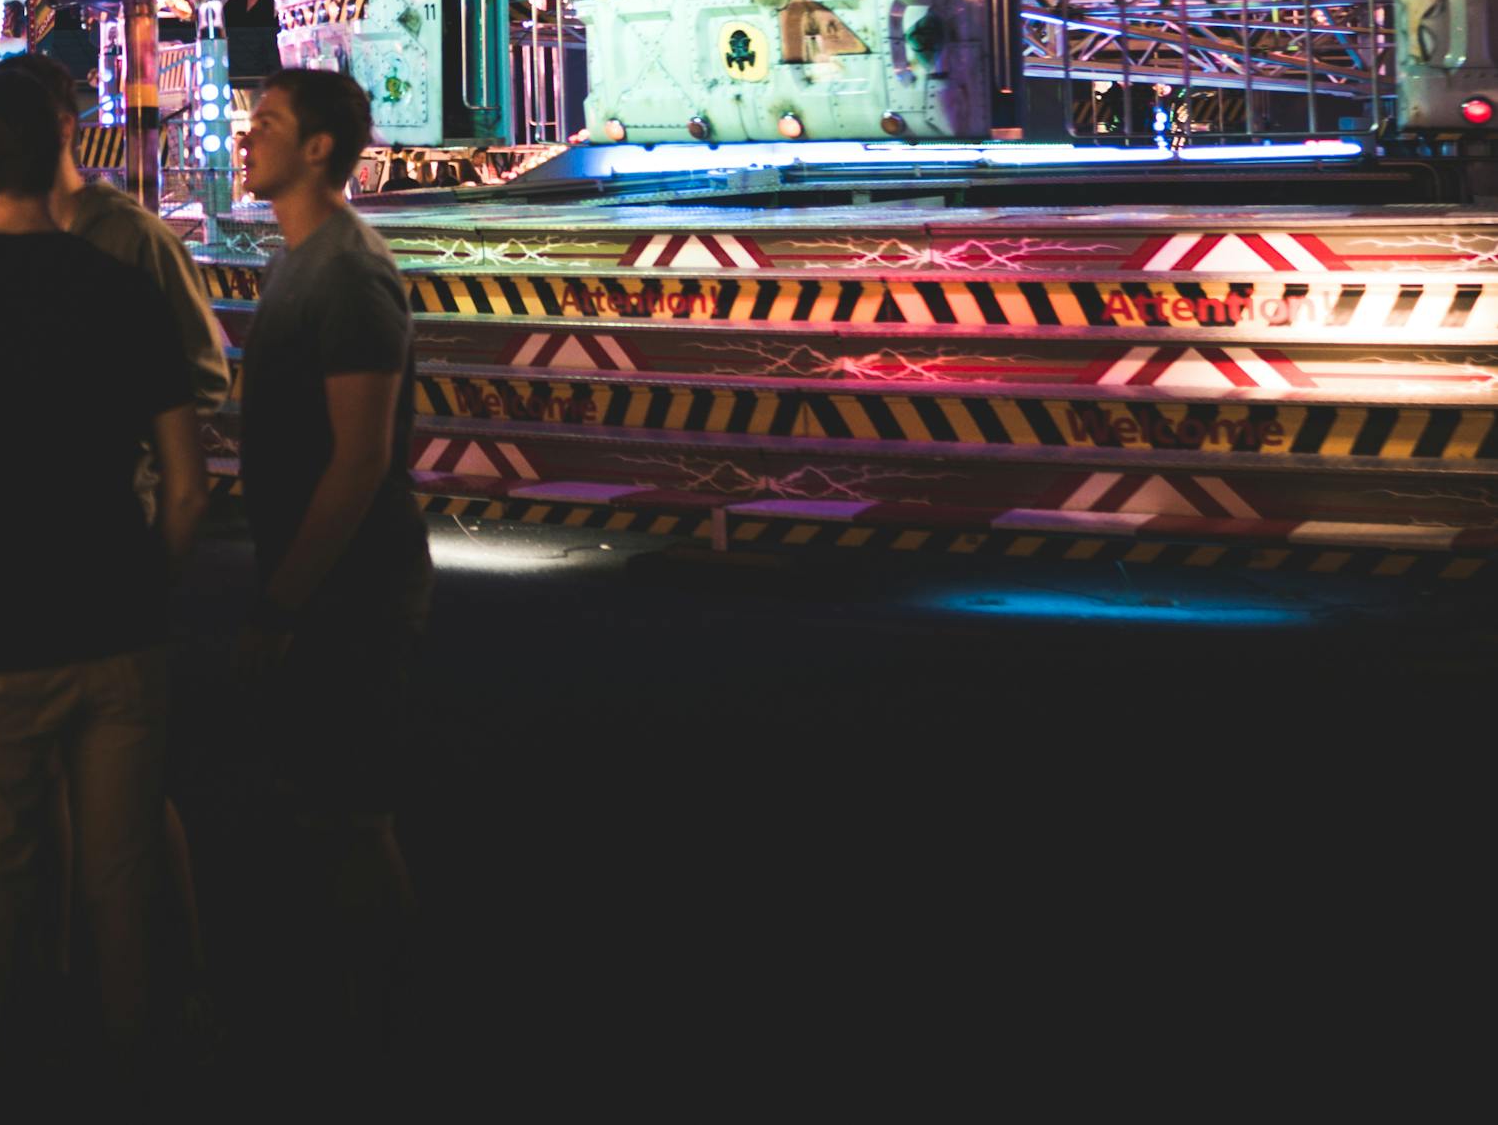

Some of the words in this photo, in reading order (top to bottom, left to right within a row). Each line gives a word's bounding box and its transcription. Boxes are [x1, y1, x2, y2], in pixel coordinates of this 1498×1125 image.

[424, 3, 436, 21] 11
[561, 283, 719, 315] Attention!
[1102, 289, 1339, 326] Attention!
[454, 383, 598, 422] Welcome
[1065, 408, 1285, 448] Welcome
